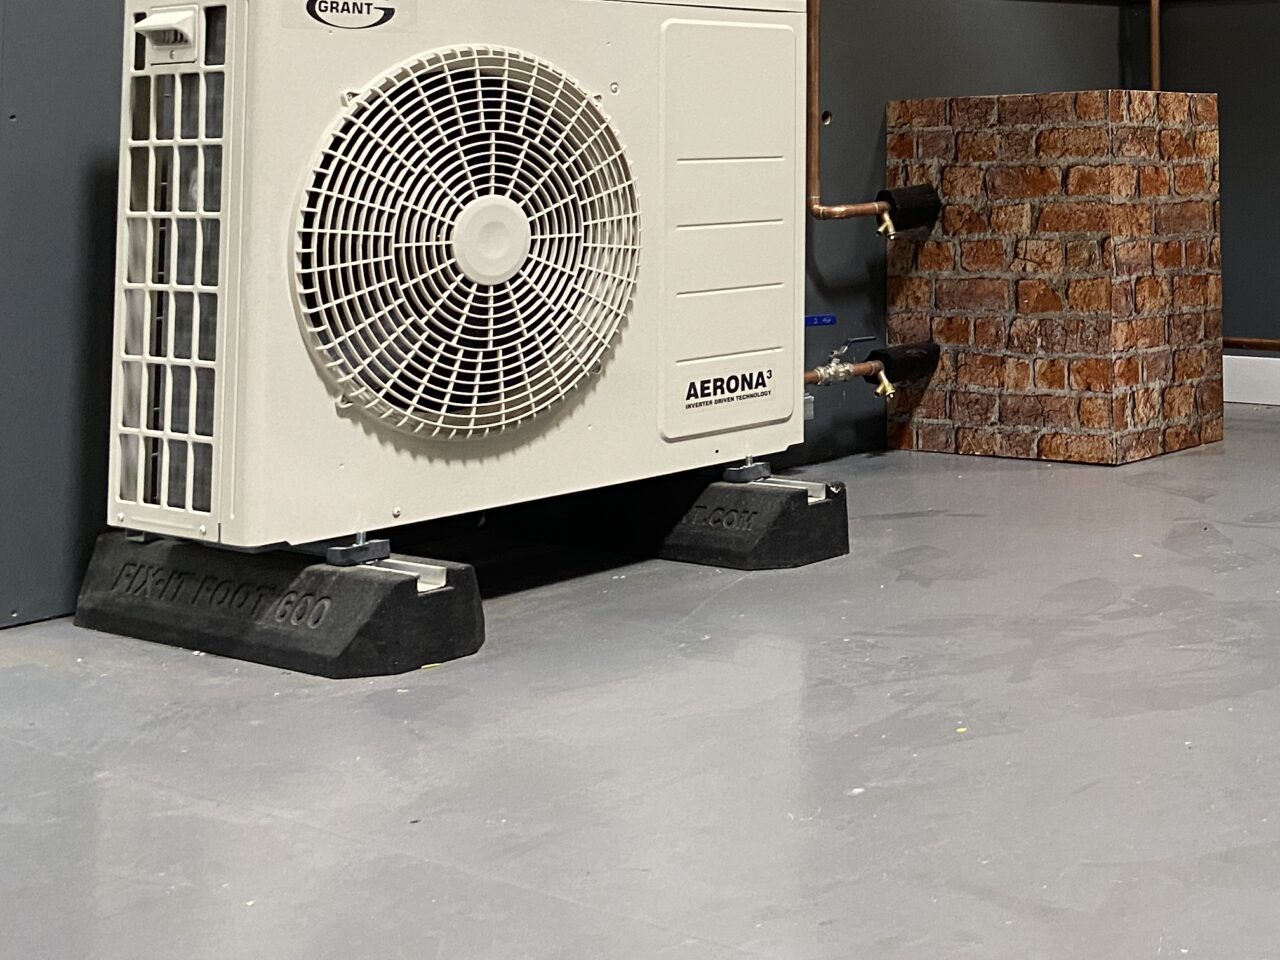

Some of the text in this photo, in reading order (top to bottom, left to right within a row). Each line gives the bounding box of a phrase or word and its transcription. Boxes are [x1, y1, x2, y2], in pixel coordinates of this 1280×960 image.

[318, 0, 374, 15] GRANT
[685, 390, 772, 410] INVERTER DRIVEN TECHNOLOGY
[111, 563, 332, 630] FIX-IT FOOT 600
